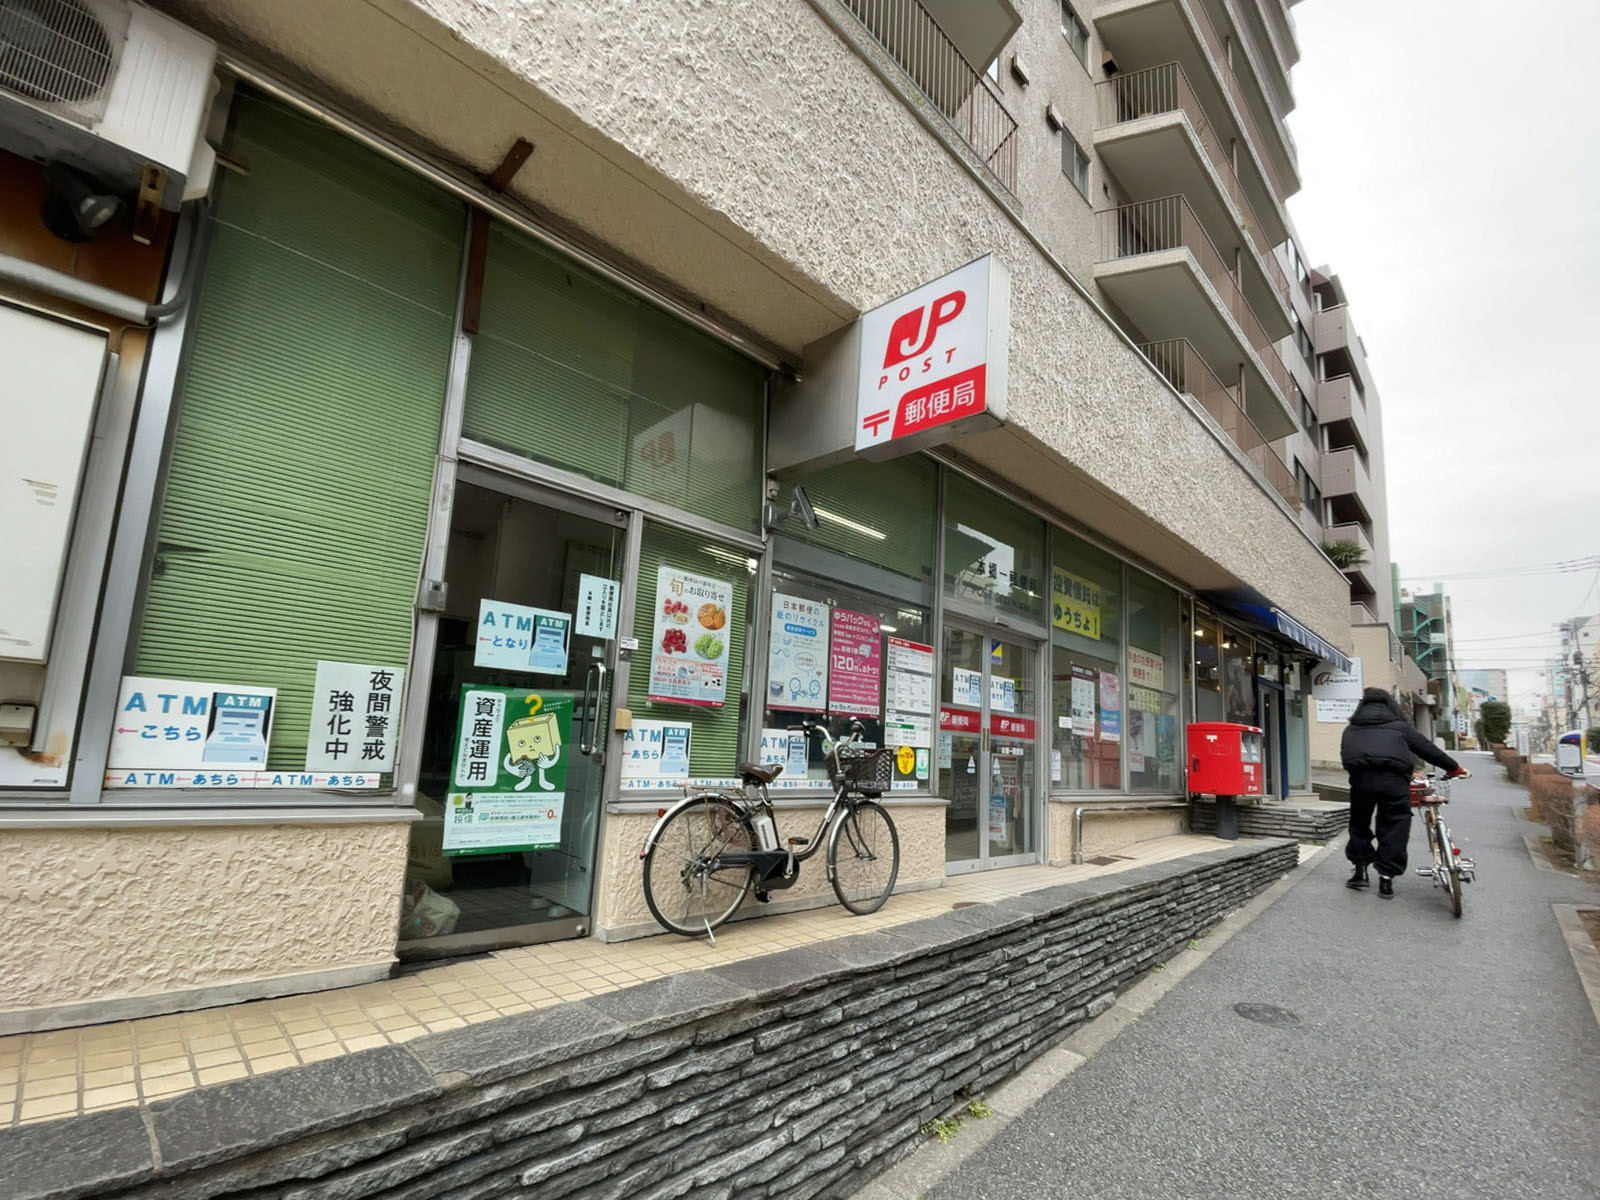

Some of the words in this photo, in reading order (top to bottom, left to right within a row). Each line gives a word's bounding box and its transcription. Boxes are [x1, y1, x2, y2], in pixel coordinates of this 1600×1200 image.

[883, 290, 966, 369] JP
[878, 347, 956, 391] POST
[904, 380, 975, 426] 郵便局
[784, 600, 820, 616] 日本郵便の
[483, 611, 531, 632] ATM
[540, 617, 564, 628] ATM
[492, 635, 528, 650] となり
[124, 692, 208, 716] ATM
[224, 695, 262, 708] ATM
[361, 669, 395, 761] 夜間警戒
[324, 690, 355, 761] 強化中
[140, 724, 202, 741] こちら
[467, 697, 495, 780] 資産運用
[625, 728, 661, 743] ATM
[667, 728, 686, 737] ATM
[760, 737, 787, 748] ATM
[631, 749, 660, 760] あちら
[766, 755, 785, 763] あちら
[125, 773, 175, 785] ATM
[192, 773, 239, 785] あちら
[272, 774, 313, 786] ATM
[327, 774, 366, 786] あちら
[628, 780, 650, 788] ATM
[692, 780, 712, 788] ATM
[718, 780, 736, 788] あちら
[454, 815, 473, 824] 投信
